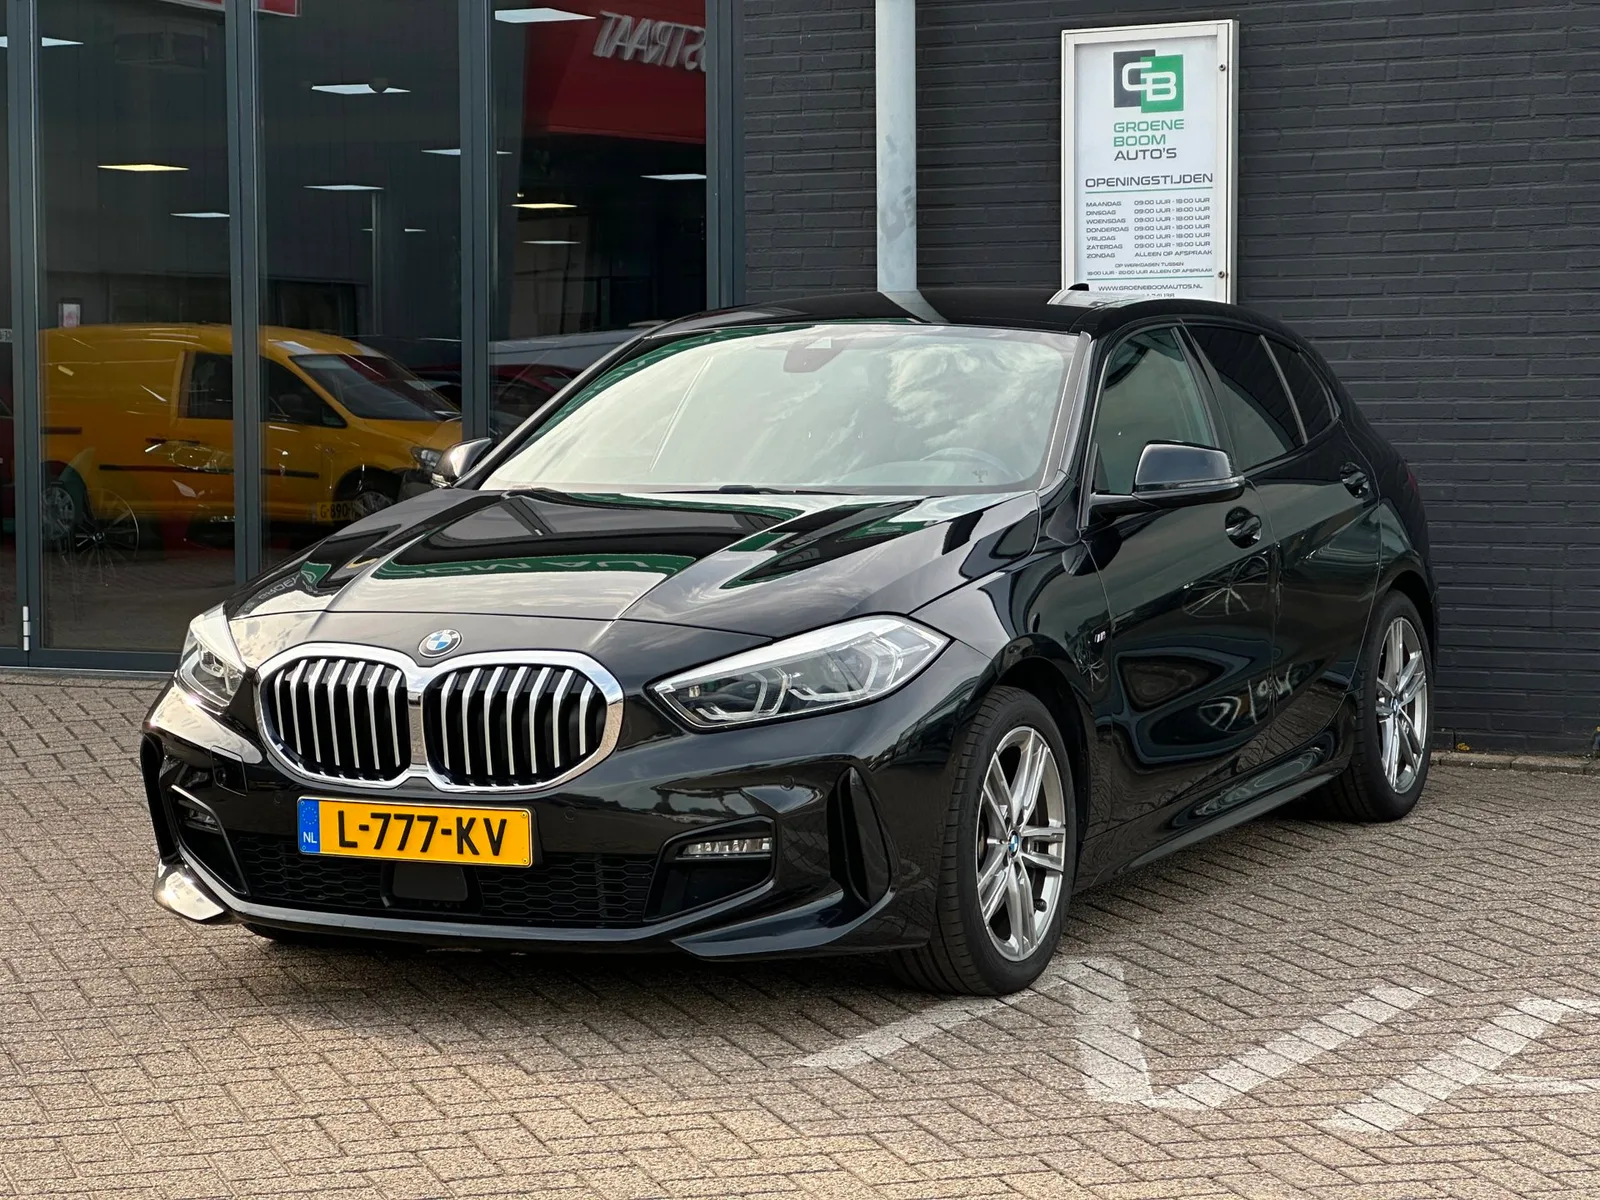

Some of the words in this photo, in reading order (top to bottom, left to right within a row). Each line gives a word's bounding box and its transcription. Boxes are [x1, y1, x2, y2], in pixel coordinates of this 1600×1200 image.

[1113, 119, 1185, 133] GROENE
[1113, 134, 1166, 147] BOOM
[1114, 148, 1177, 161] AUTO'S
[1085, 173, 1213, 188] OPENINGSTIJDEN
[303, 831, 317, 844] NL
[338, 810, 507, 856] L-777-KV
